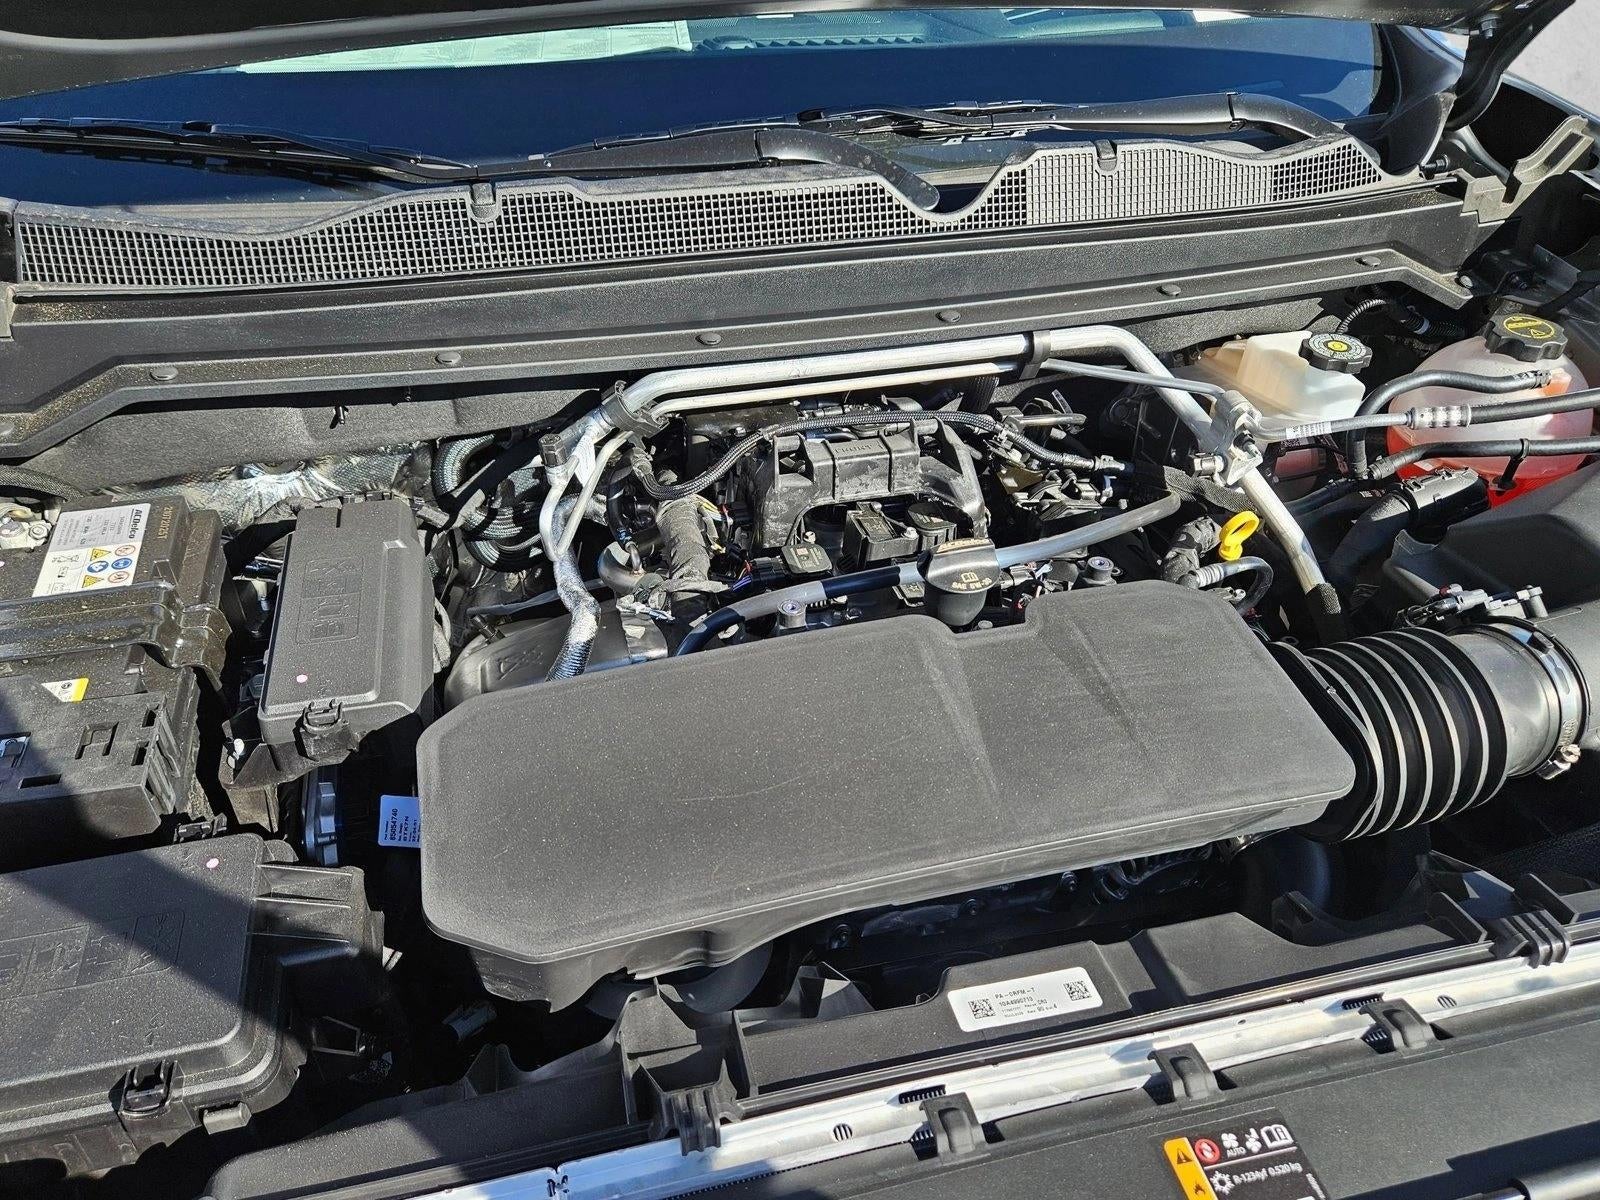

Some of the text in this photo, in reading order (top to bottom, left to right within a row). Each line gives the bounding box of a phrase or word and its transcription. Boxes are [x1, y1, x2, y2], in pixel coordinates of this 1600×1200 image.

[129, 509, 143, 539] ACDelco
[1227, 1146, 1247, 1158] AUTO
[1269, 1164, 1291, 1177] 0.520
[1288, 1162, 1303, 1174] kg
